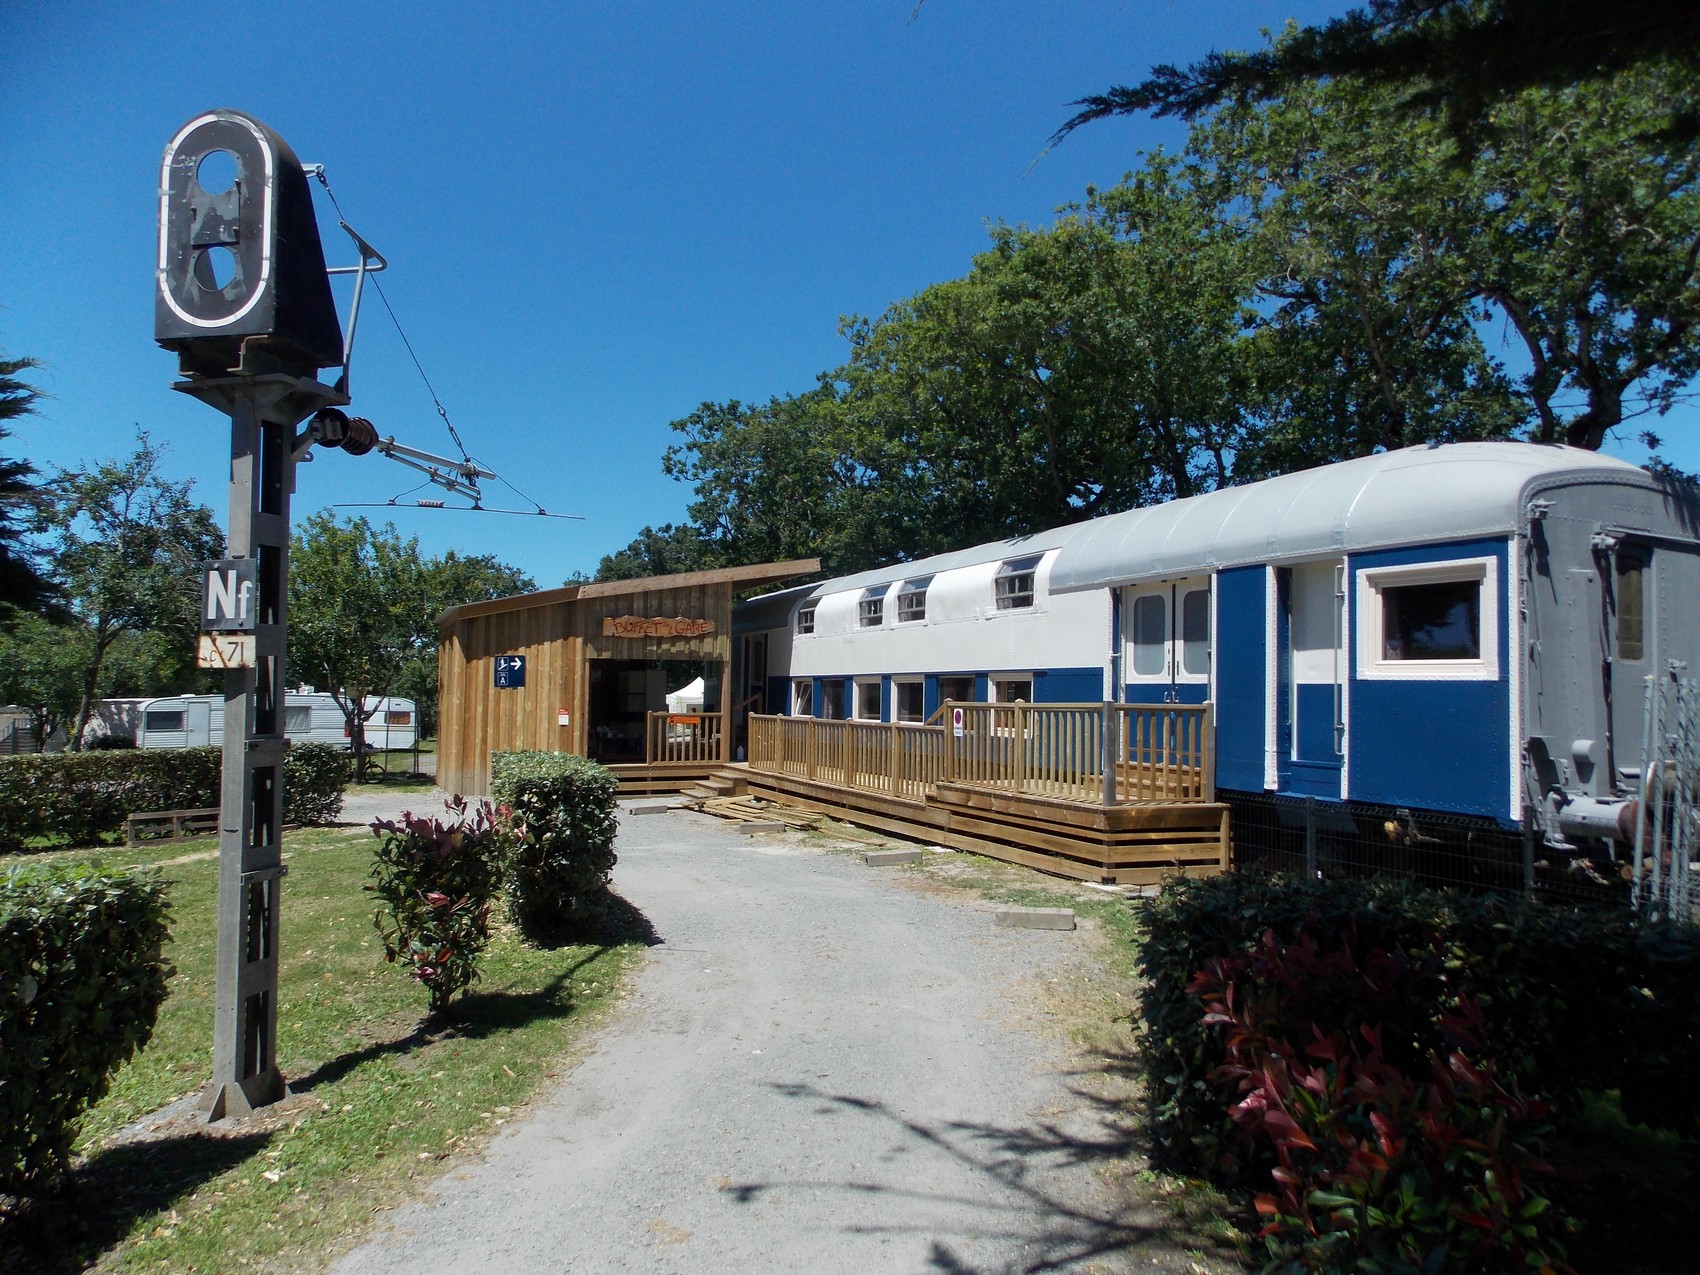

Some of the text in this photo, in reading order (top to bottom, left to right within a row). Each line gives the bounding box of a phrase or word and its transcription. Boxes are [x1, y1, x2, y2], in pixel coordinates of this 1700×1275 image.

[207, 569, 253, 620] Nf
[613, 619, 662, 635] BUFFET
[675, 620, 708, 635] GARE
[227, 641, 245, 662] 71
